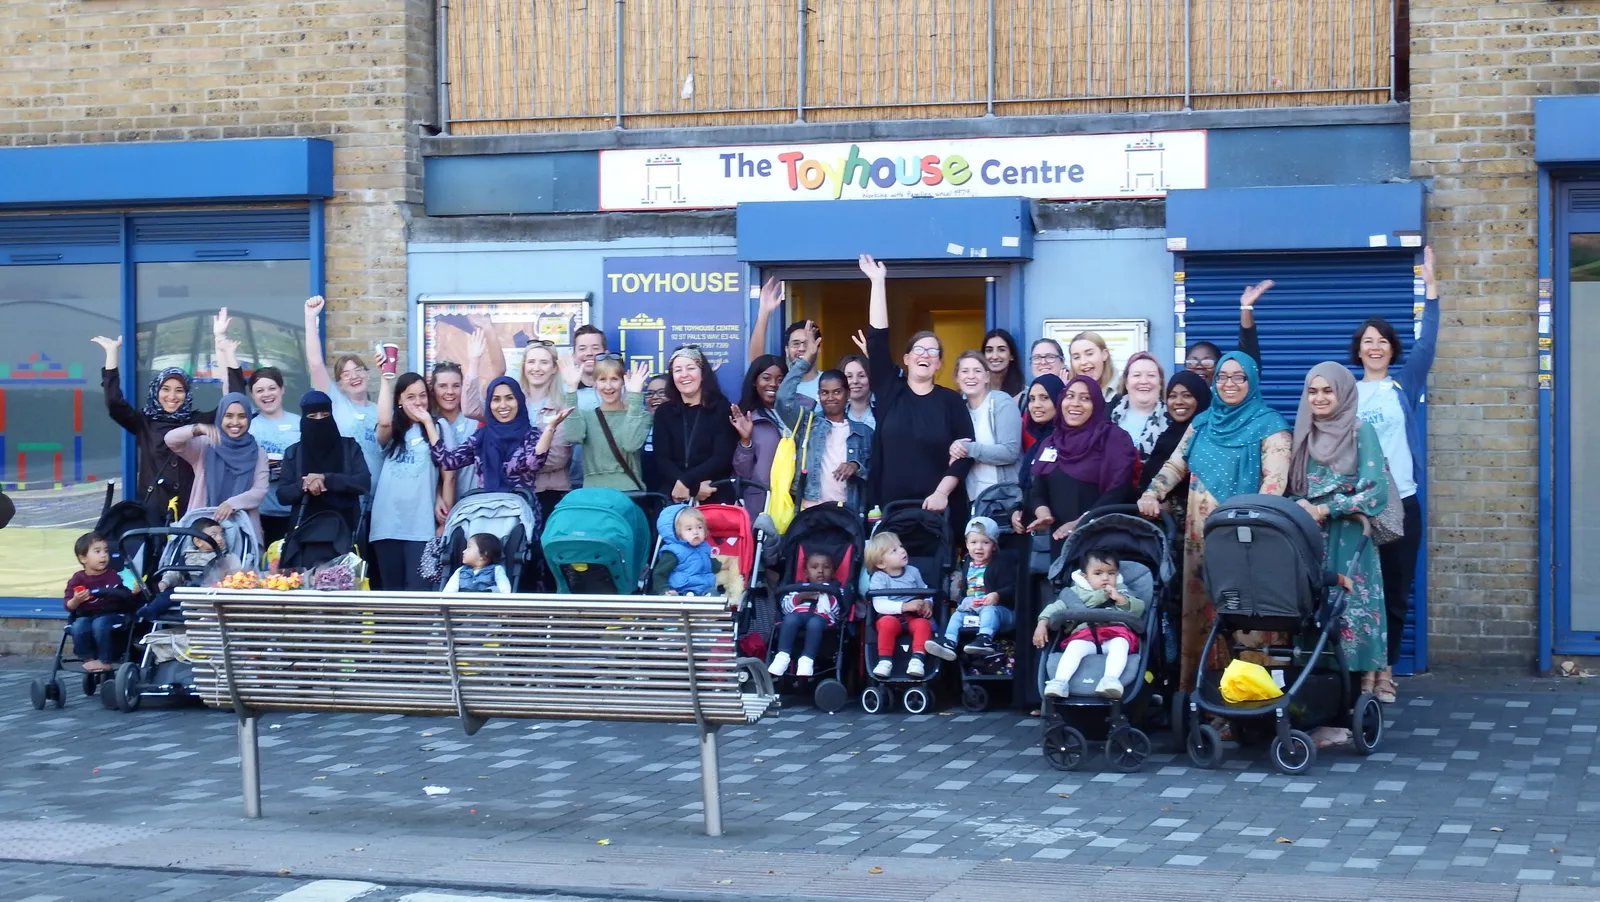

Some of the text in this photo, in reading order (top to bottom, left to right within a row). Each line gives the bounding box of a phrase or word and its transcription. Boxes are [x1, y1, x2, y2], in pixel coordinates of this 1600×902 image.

[719, 144, 1085, 199] The Toyhouse Centre
[607, 272, 740, 293] TOYHOUSE
